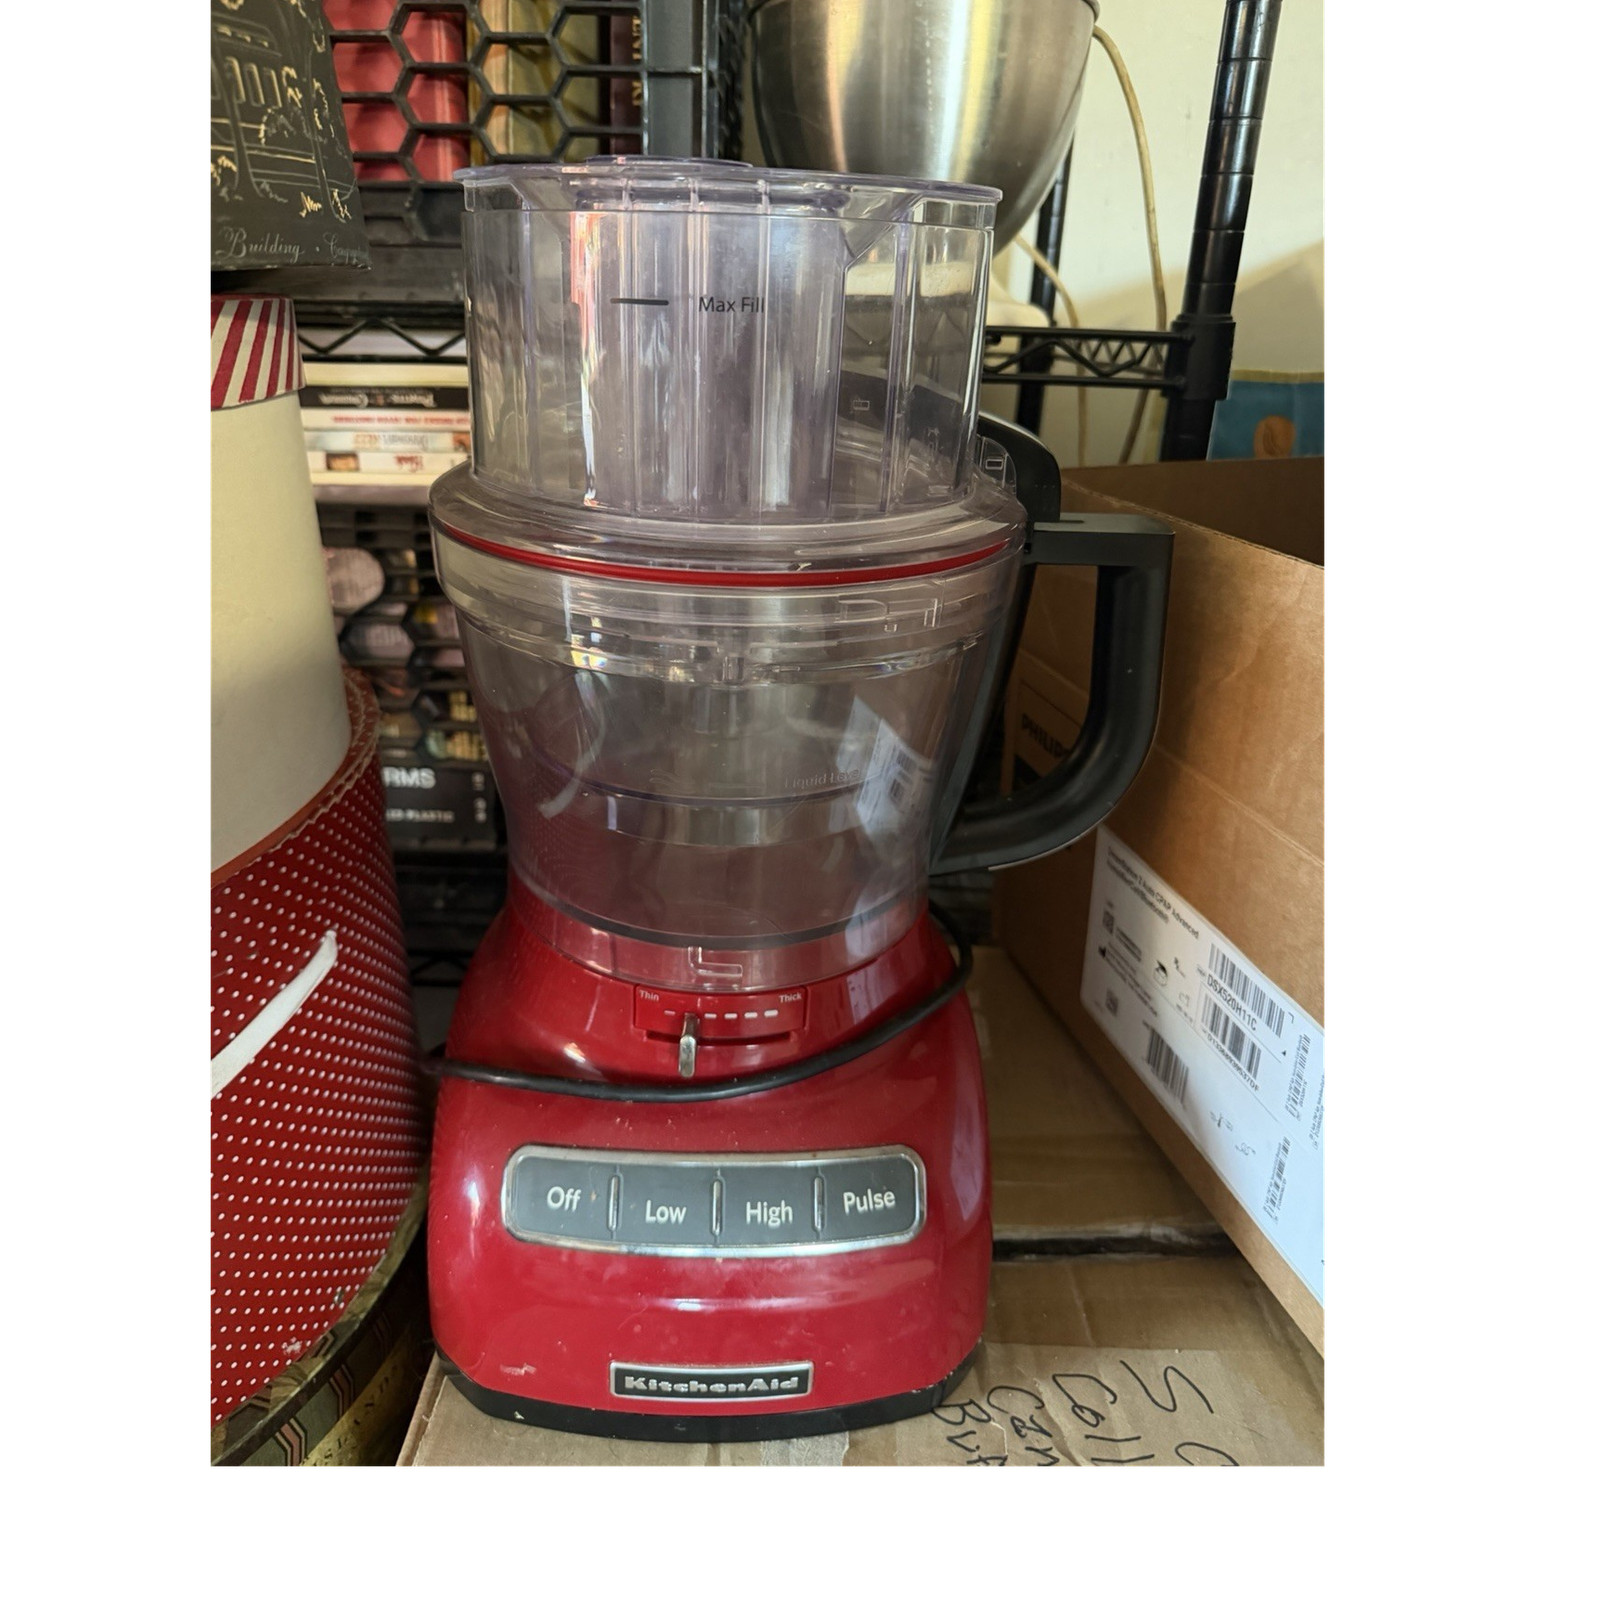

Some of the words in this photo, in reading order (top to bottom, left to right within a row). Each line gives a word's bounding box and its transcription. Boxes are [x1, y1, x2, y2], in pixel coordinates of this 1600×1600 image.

[215, 226, 304, 264] Building
[698, 297, 736, 313] Max
[741, 297, 765, 313] Fill
[639, 989, 660, 1002] Thin
[779, 991, 802, 1003] Thick
[1206, 974, 1258, 1032] DSX520H11C
[546, 1185, 581, 1212] Off
[843, 1189, 896, 1214] Pulse
[645, 1200, 687, 1225] Low
[745, 1200, 794, 1229] High
[623, 1375, 800, 1394] KitchenAid
